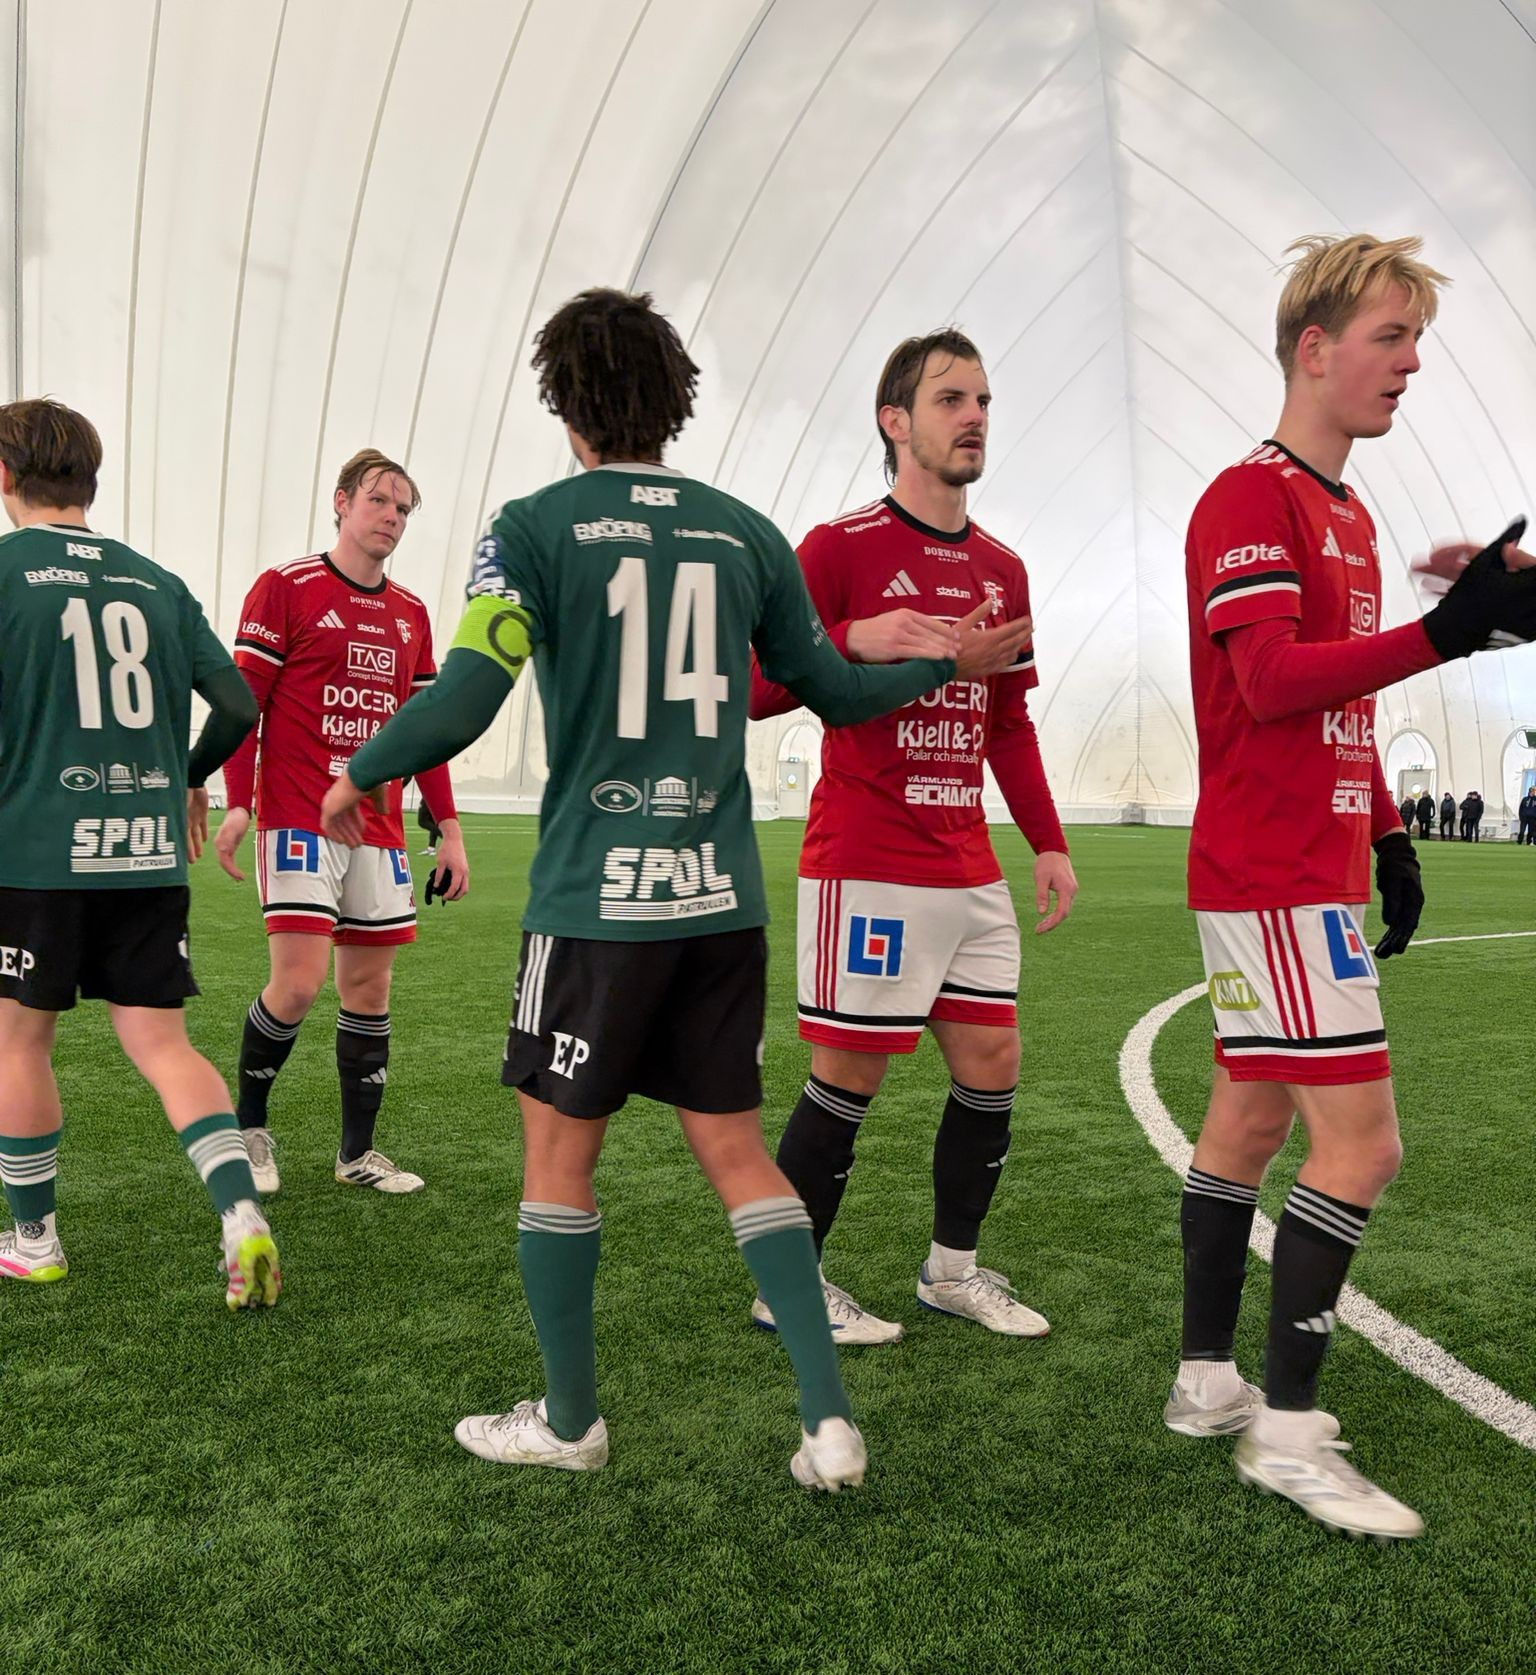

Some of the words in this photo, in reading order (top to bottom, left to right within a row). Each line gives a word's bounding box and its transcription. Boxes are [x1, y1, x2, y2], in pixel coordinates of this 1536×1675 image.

[924, 546, 970, 561] DORWARD
[242, 622, 281, 644] LEDtec
[356, 623, 386, 635] stadium
[60, 597, 155, 729] 18
[353, 648, 392, 669] TAG
[607, 557, 729, 739] 14
[905, 784, 981, 807] SCHAKT
[70, 816, 176, 857] SPOL
[600, 842, 733, 899] SPOL
[0, 945, 35, 981] EP
[548, 1031, 590, 1080] EP
